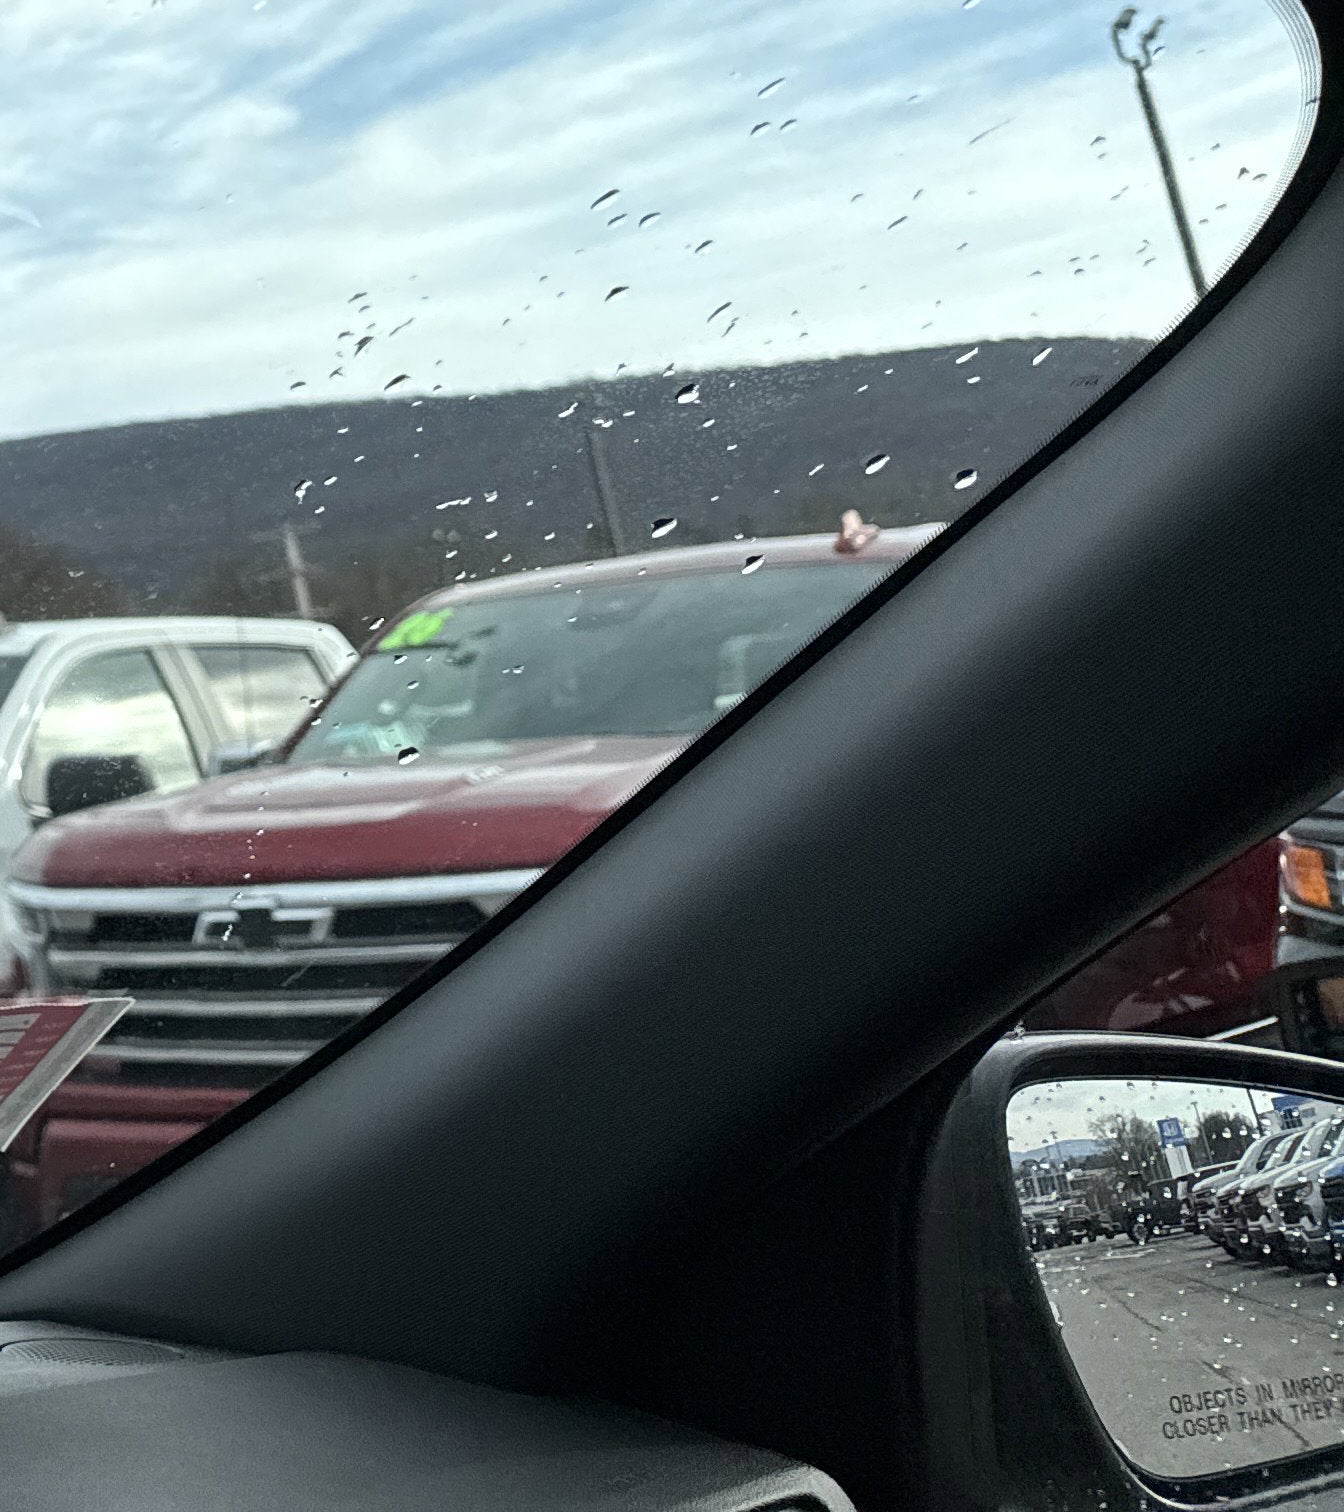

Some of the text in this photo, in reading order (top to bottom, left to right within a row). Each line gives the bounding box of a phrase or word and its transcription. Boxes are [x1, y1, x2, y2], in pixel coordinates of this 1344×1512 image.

[1169, 1373, 1344, 1414] OBJECTS IN MIRROR
[1162, 1414, 1231, 1439] CLOSER
[1236, 1407, 1283, 1430] THAN
[1288, 1399, 1332, 1424] THEY
